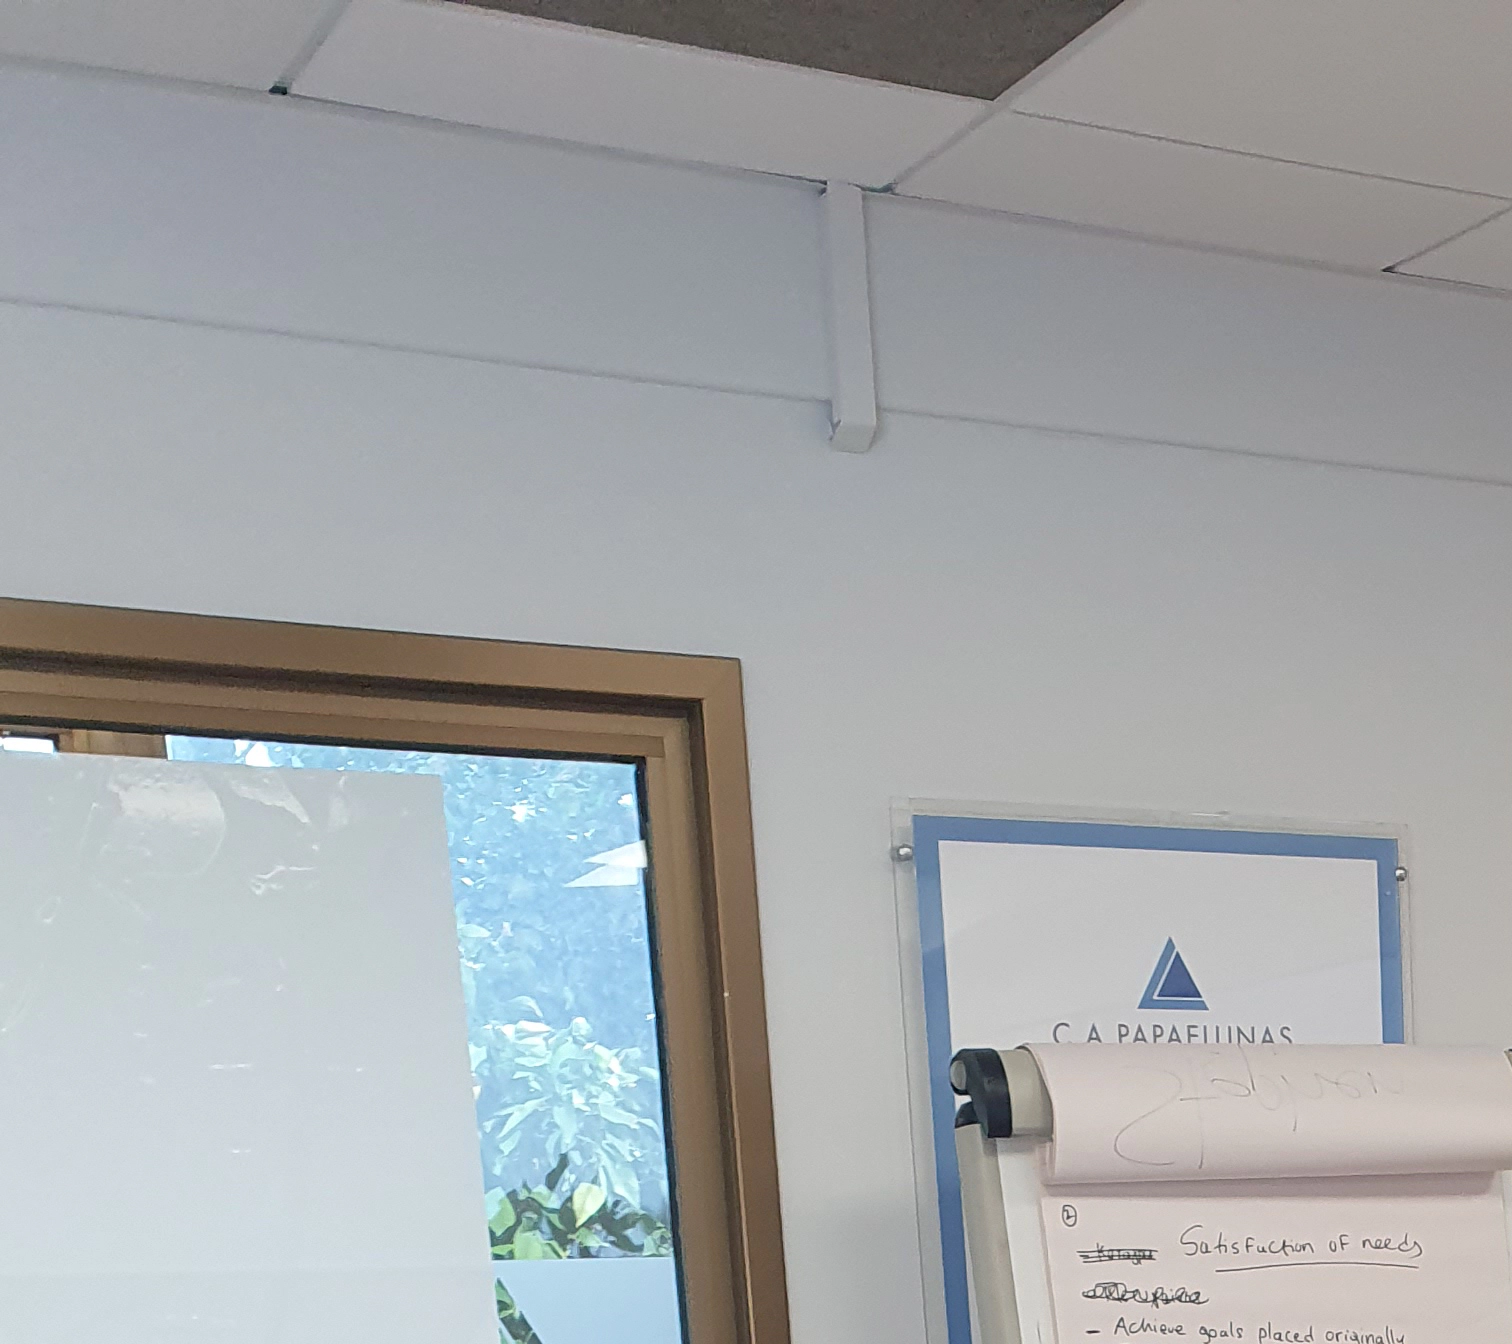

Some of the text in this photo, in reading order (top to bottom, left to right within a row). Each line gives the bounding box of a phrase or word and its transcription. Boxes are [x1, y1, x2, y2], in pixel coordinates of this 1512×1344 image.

[1180, 1225, 1315, 1258] Satisfaction
[1362, 1233, 1423, 1259] needs
[1113, 1316, 1187, 1337] Achieve
[1199, 1320, 1244, 1344] goals
[1258, 1321, 1315, 1344] placed
